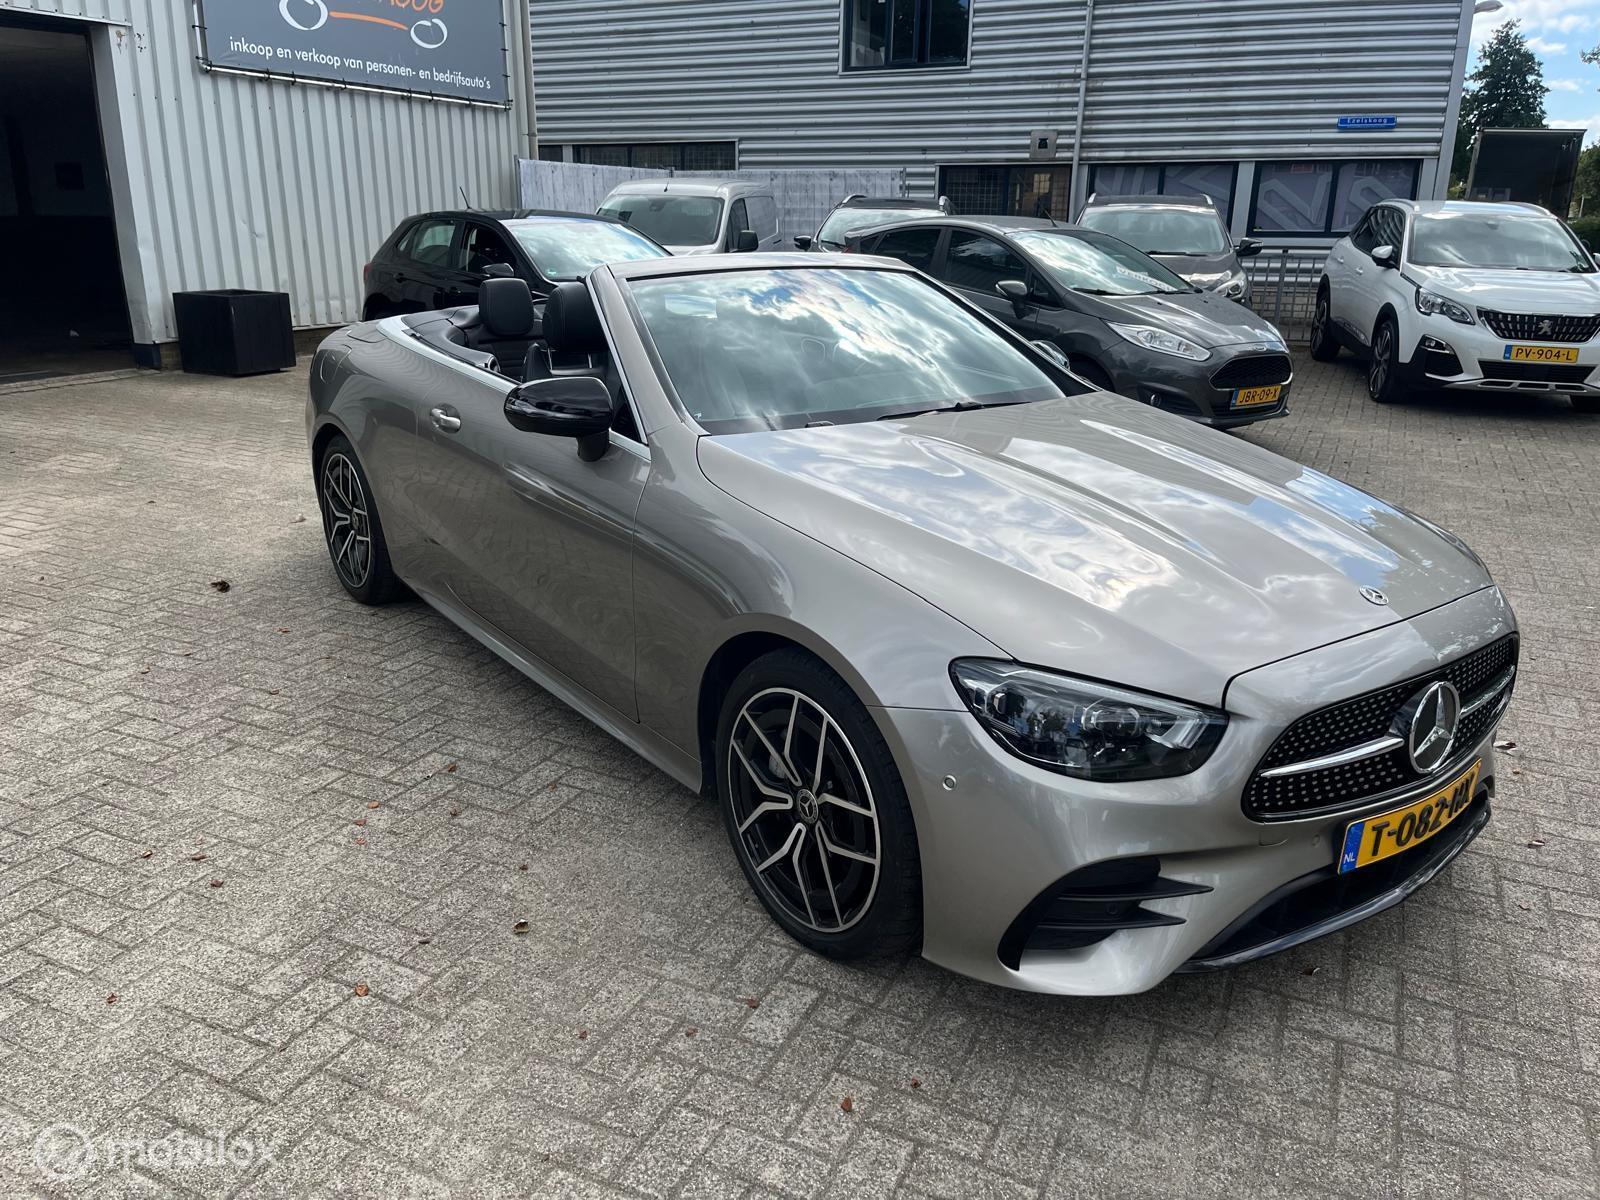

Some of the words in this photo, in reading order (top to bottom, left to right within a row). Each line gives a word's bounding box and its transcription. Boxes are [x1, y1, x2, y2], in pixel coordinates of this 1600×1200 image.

[229, 36, 273, 60] inkoop
[276, 47, 292, 59] en
[294, 48, 341, 69] verkoop
[343, 57, 364, 69] van
[366, 61, 416, 77] personen-
[418, 68, 431, 80] en
[433, 67, 491, 90] bedrijfsauto's
[1515, 348, 1573, 361] PV-904-L
[1239, 387, 1279, 403] JBR-09-X
[1343, 852, 1355, 865] NL
